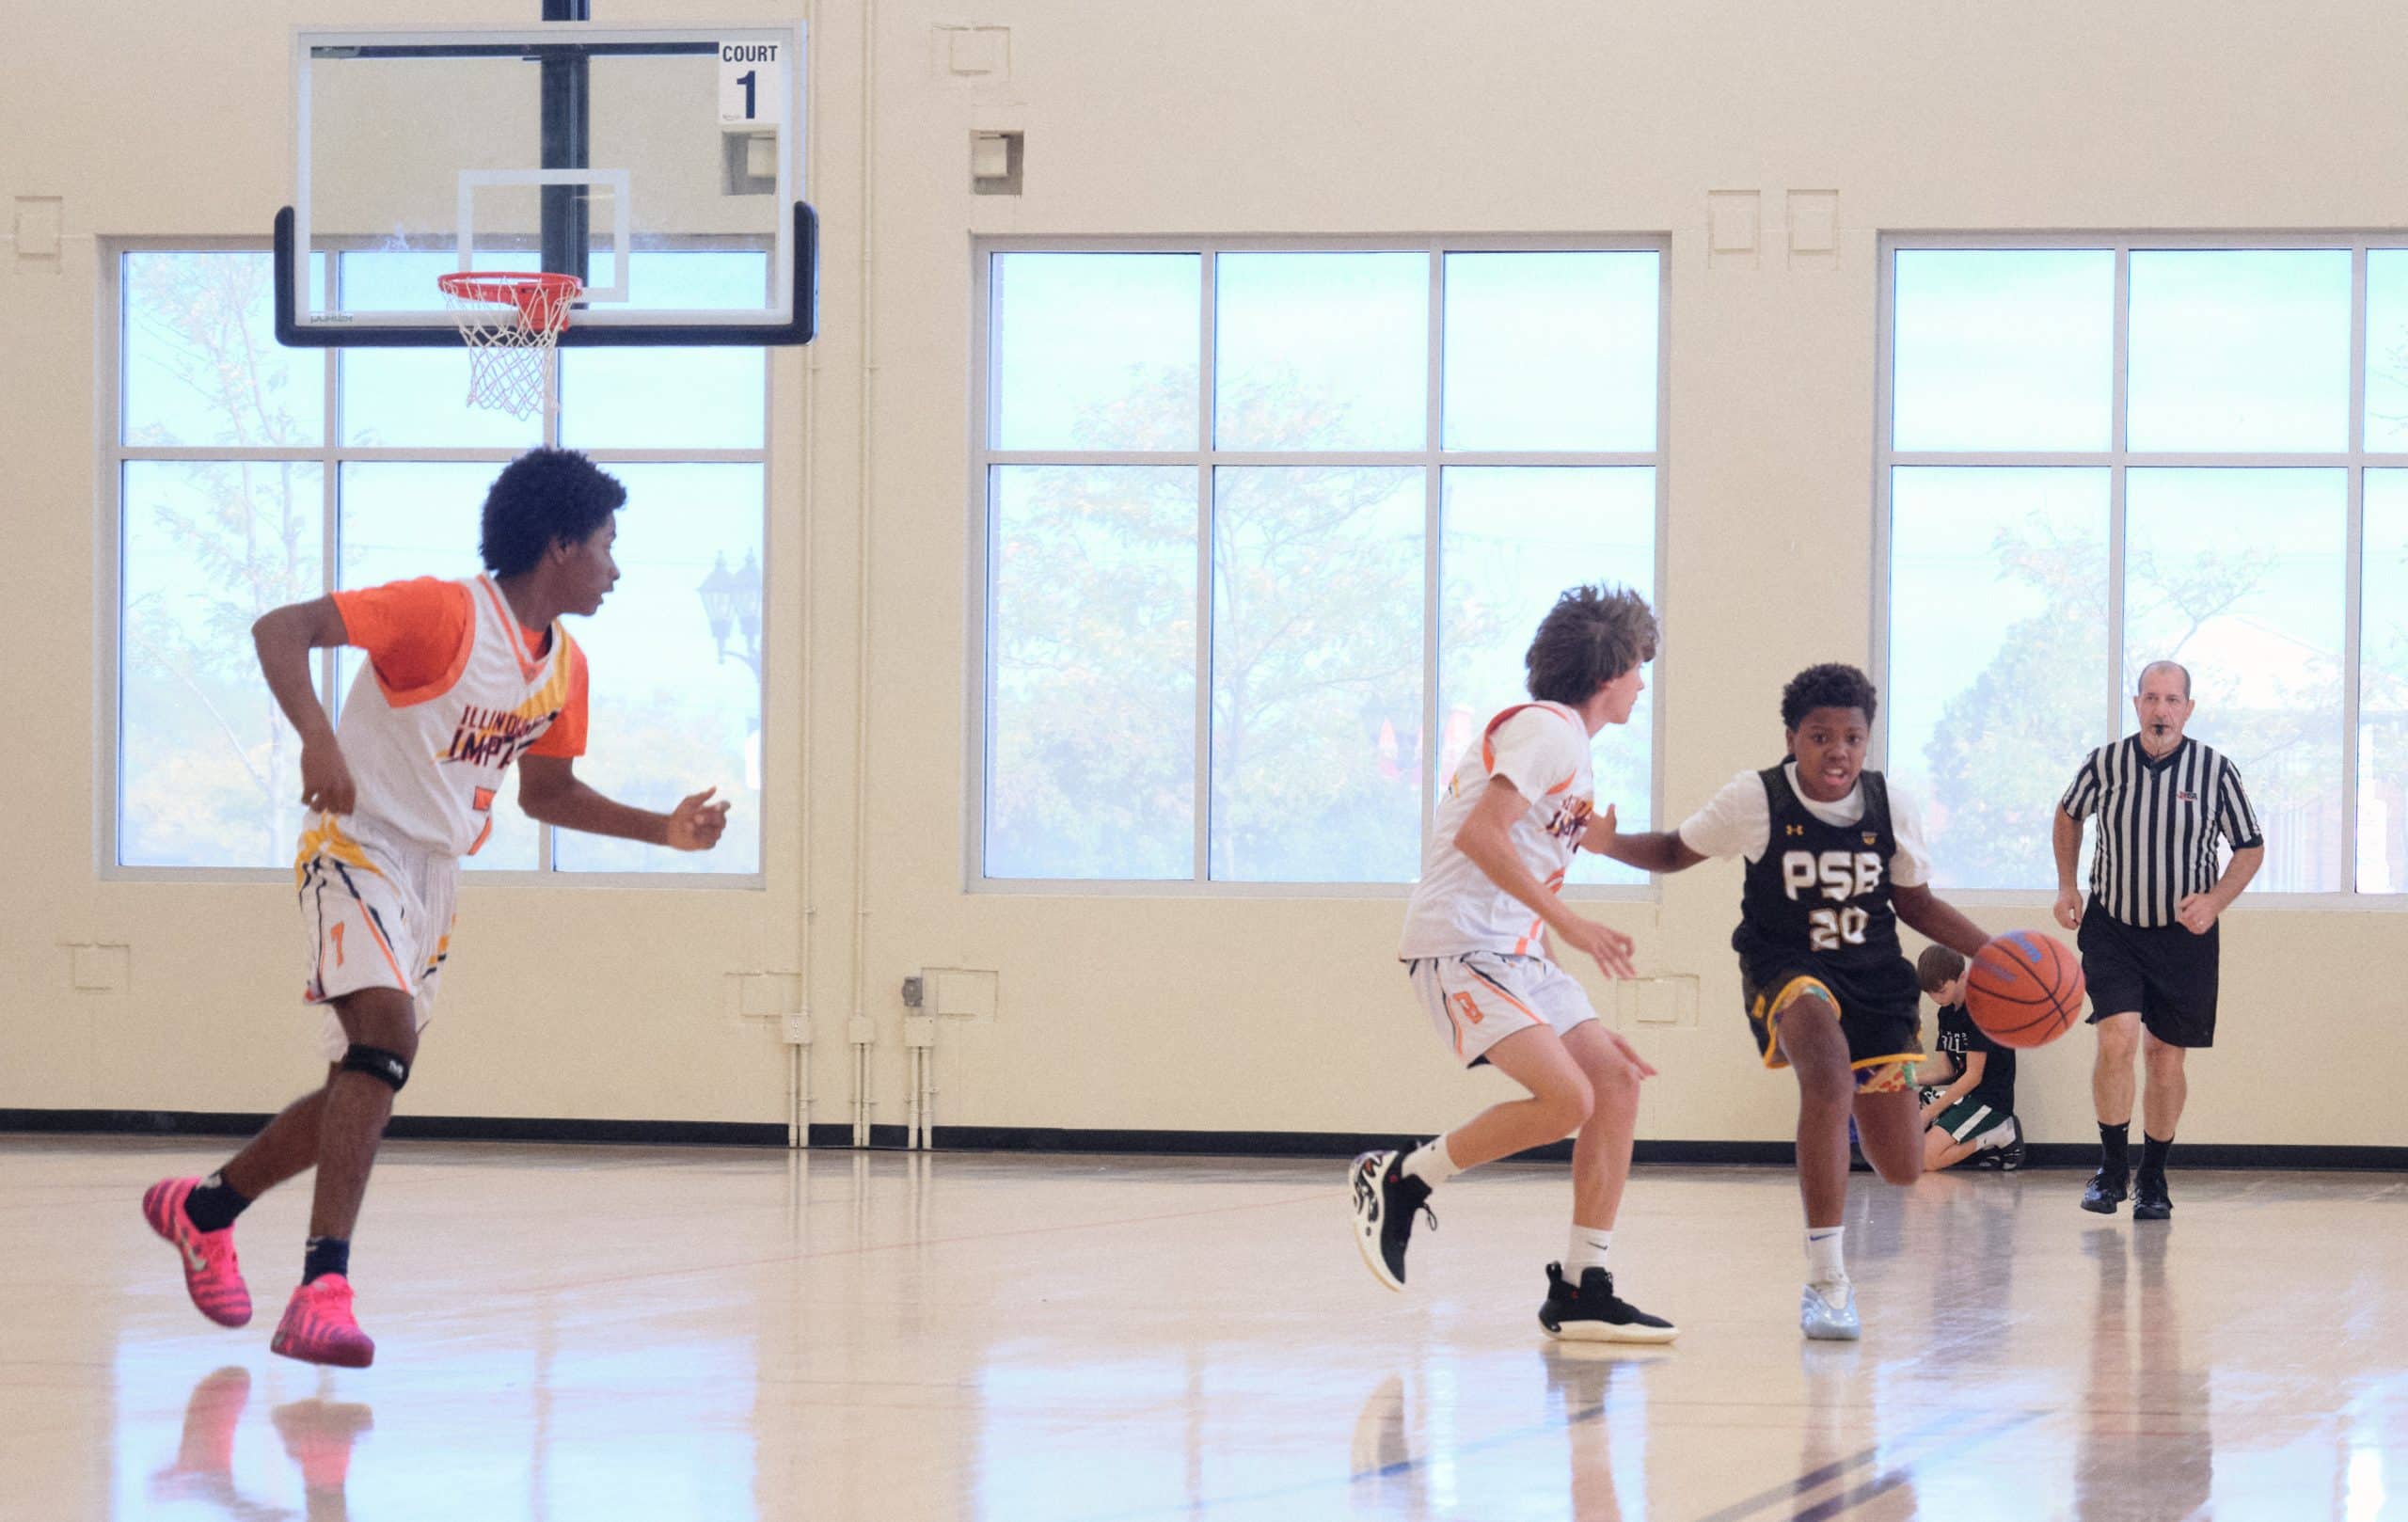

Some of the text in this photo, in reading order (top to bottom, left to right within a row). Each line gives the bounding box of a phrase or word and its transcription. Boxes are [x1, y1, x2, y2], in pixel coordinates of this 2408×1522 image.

[722, 45, 778, 62] COURT
[737, 70, 755, 119] 1
[1809, 906, 1869, 952] 20
